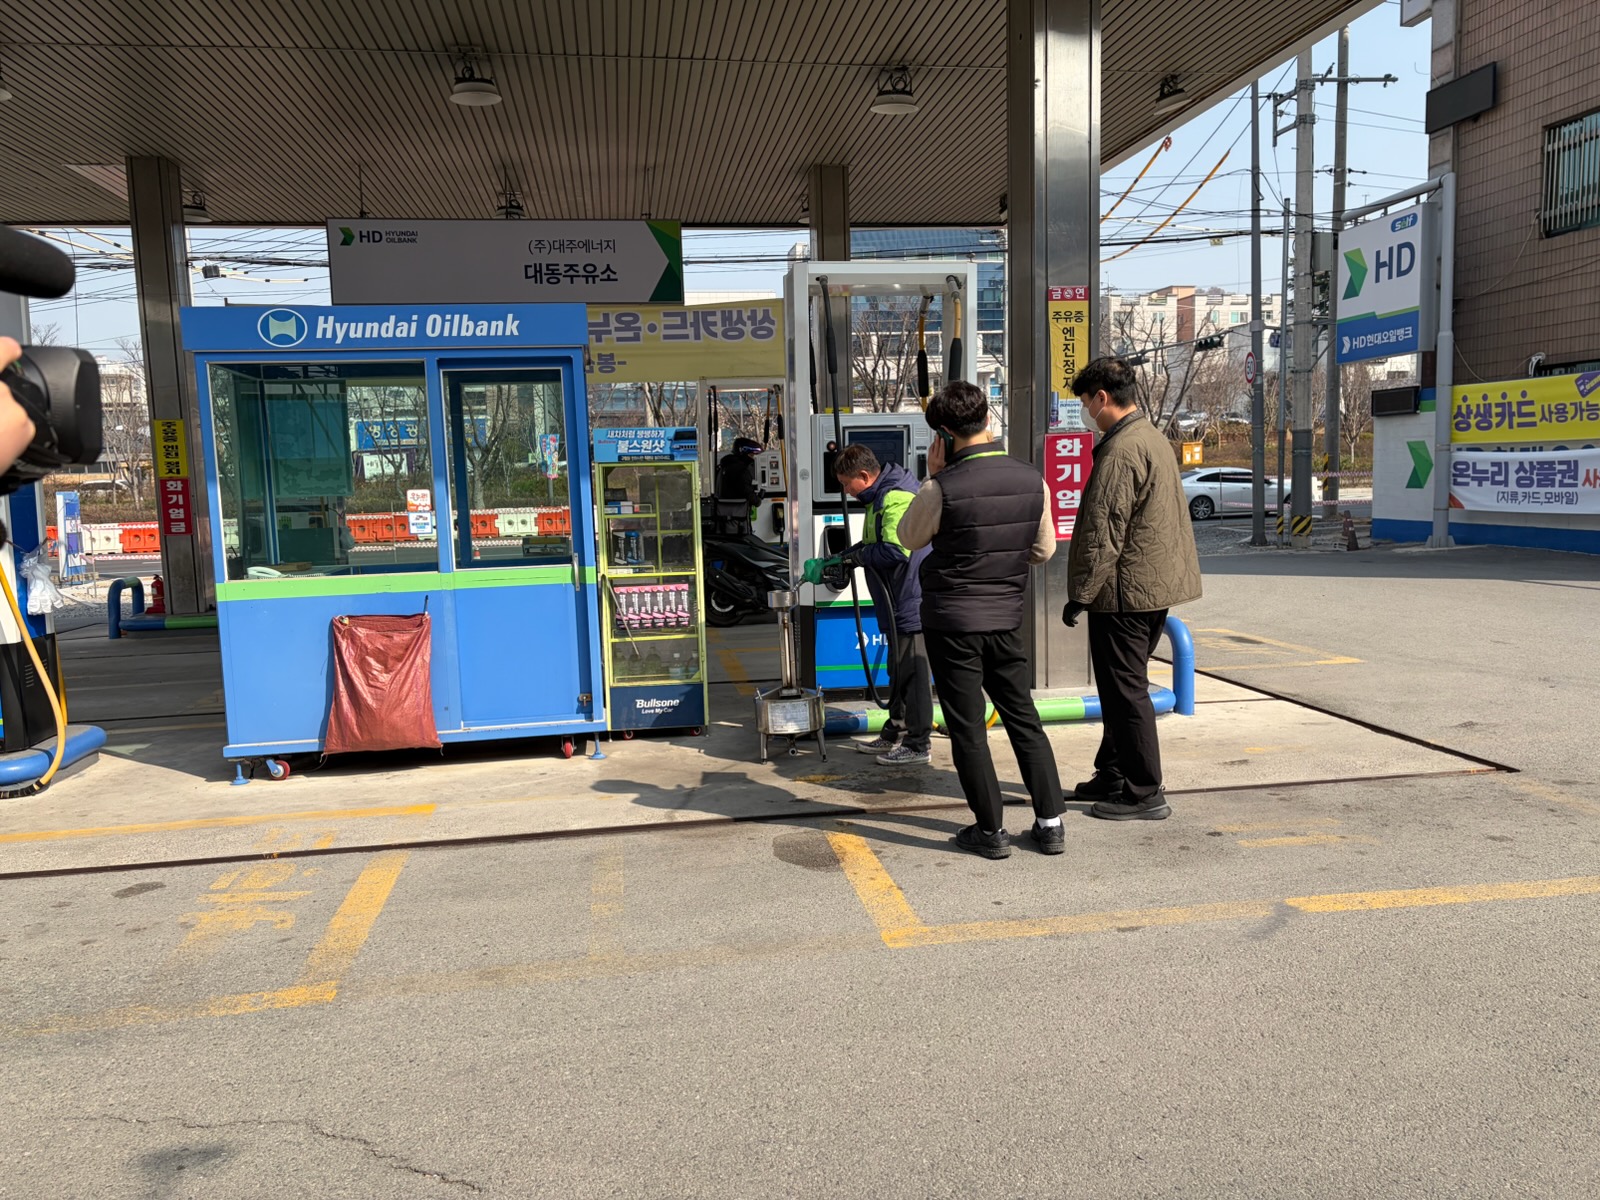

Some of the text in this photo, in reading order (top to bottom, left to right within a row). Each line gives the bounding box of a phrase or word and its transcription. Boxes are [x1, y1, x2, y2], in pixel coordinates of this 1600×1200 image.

[359, 230, 383, 243] HD
[528, 238, 616, 254] (주)대주에너지
[524, 262, 618, 285] 대동주유소
[1374, 241, 1416, 284] HD
[1051, 287, 1085, 299] 금 연
[1052, 310, 1085, 323] 주유중
[316, 313, 520, 344] Hyundai Oilbank
[1352, 326, 1413, 350] HD현대오일뱅크
[1453, 390, 1600, 432] 상생카드 사용가능
[617, 439, 666, 454] 불스원샷
[1451, 459, 1600, 488] 온누리 상품권 사
[1055, 438, 1084, 535] 화기엄금
[1496, 491, 1579, 505] (지류,카드,모바일)
[166, 480, 186, 533] 화기엄금
[635, 698, 680, 709] Bullsone
